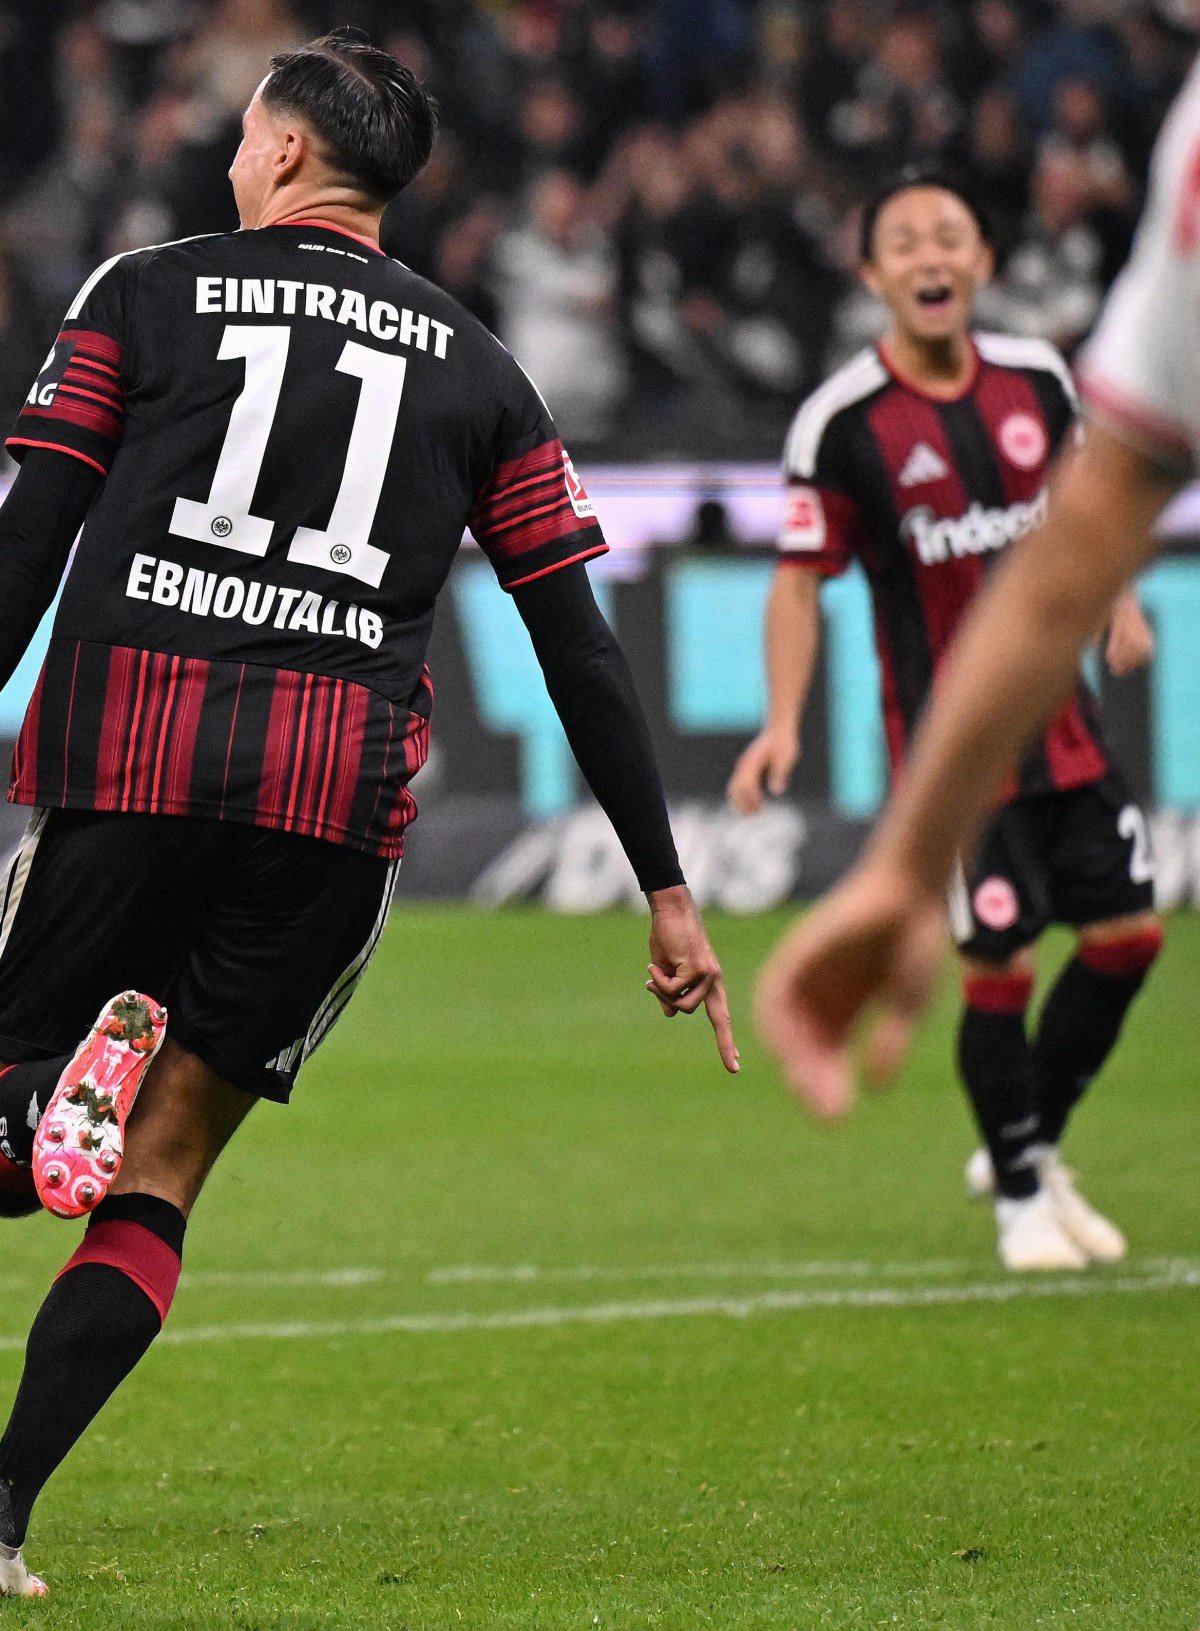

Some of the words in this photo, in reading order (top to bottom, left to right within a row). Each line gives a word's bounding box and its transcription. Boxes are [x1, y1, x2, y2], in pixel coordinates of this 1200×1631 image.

[195, 276, 454, 360] EINTRACHT
[168, 324, 408, 589] 11
[125, 552, 385, 651] EBNOUTALIB
